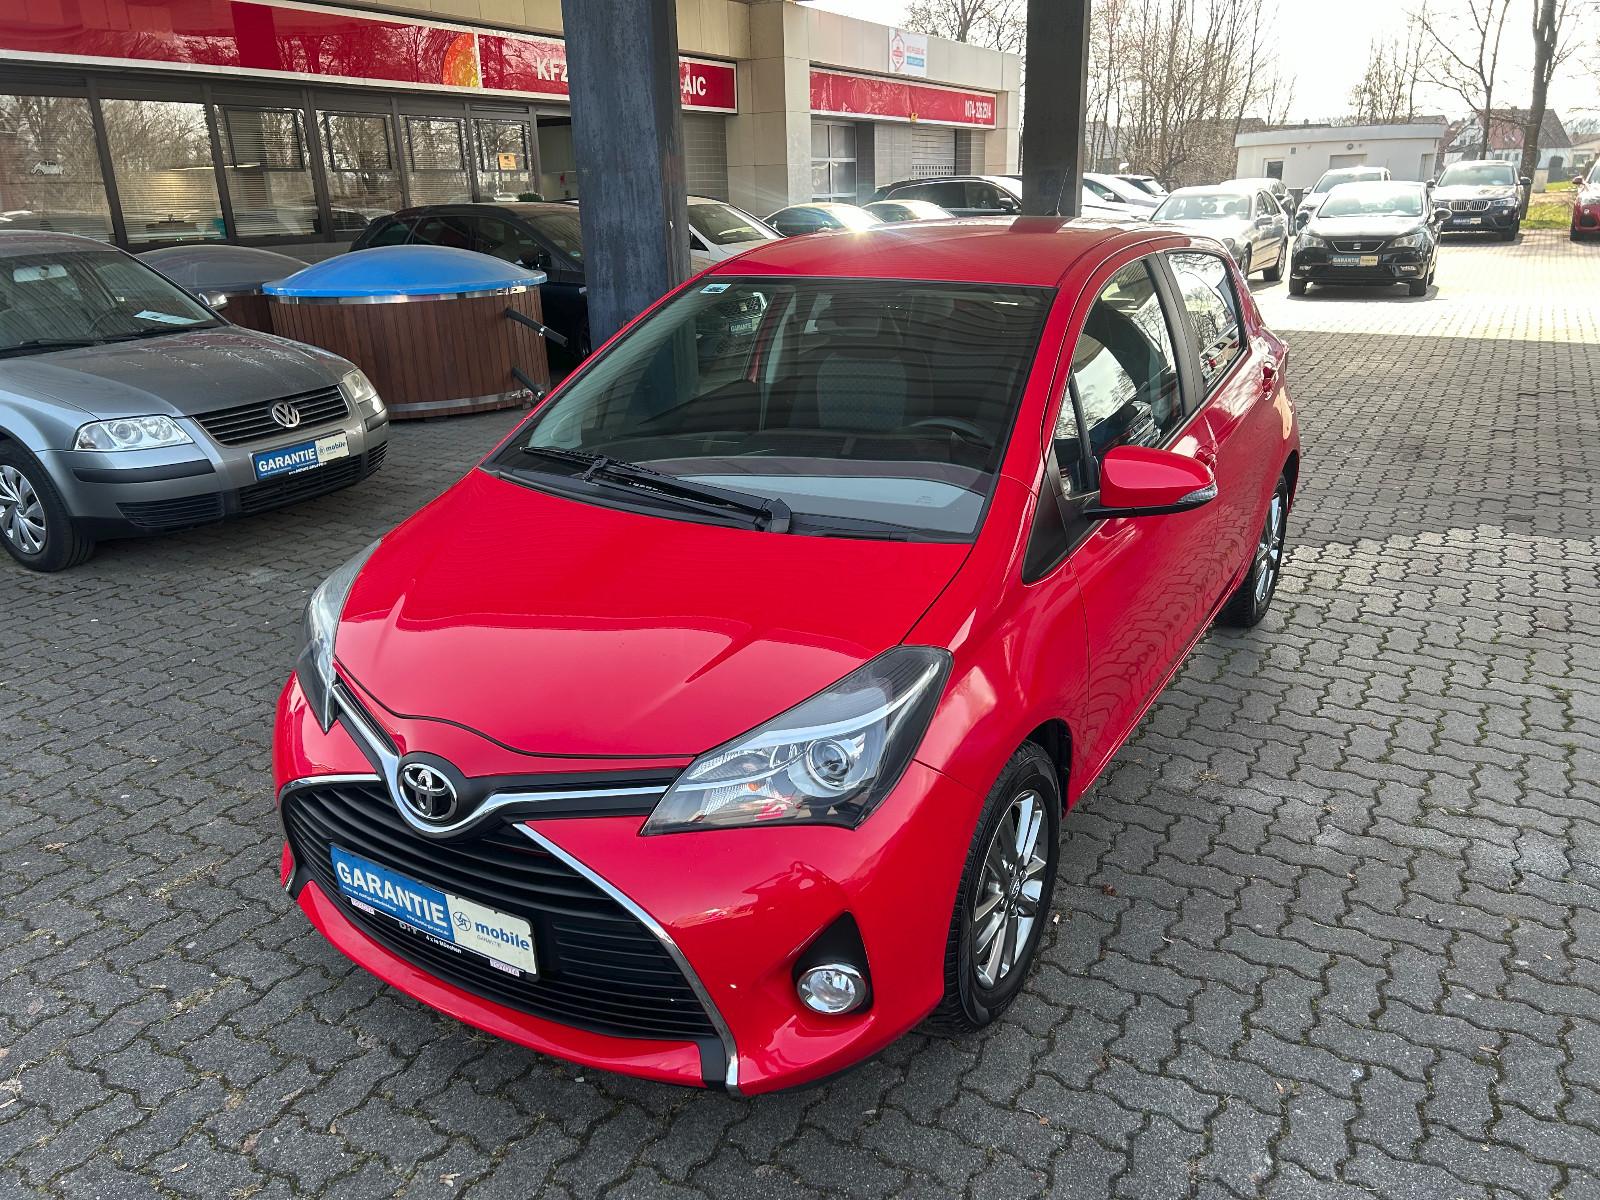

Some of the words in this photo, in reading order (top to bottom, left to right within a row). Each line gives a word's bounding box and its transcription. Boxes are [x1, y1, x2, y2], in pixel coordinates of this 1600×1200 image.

[258, 447, 316, 472] GARANTIE
[325, 441, 346, 452] mobile
[336, 861, 448, 927] GARANTIE
[474, 921, 530, 951] mobile
